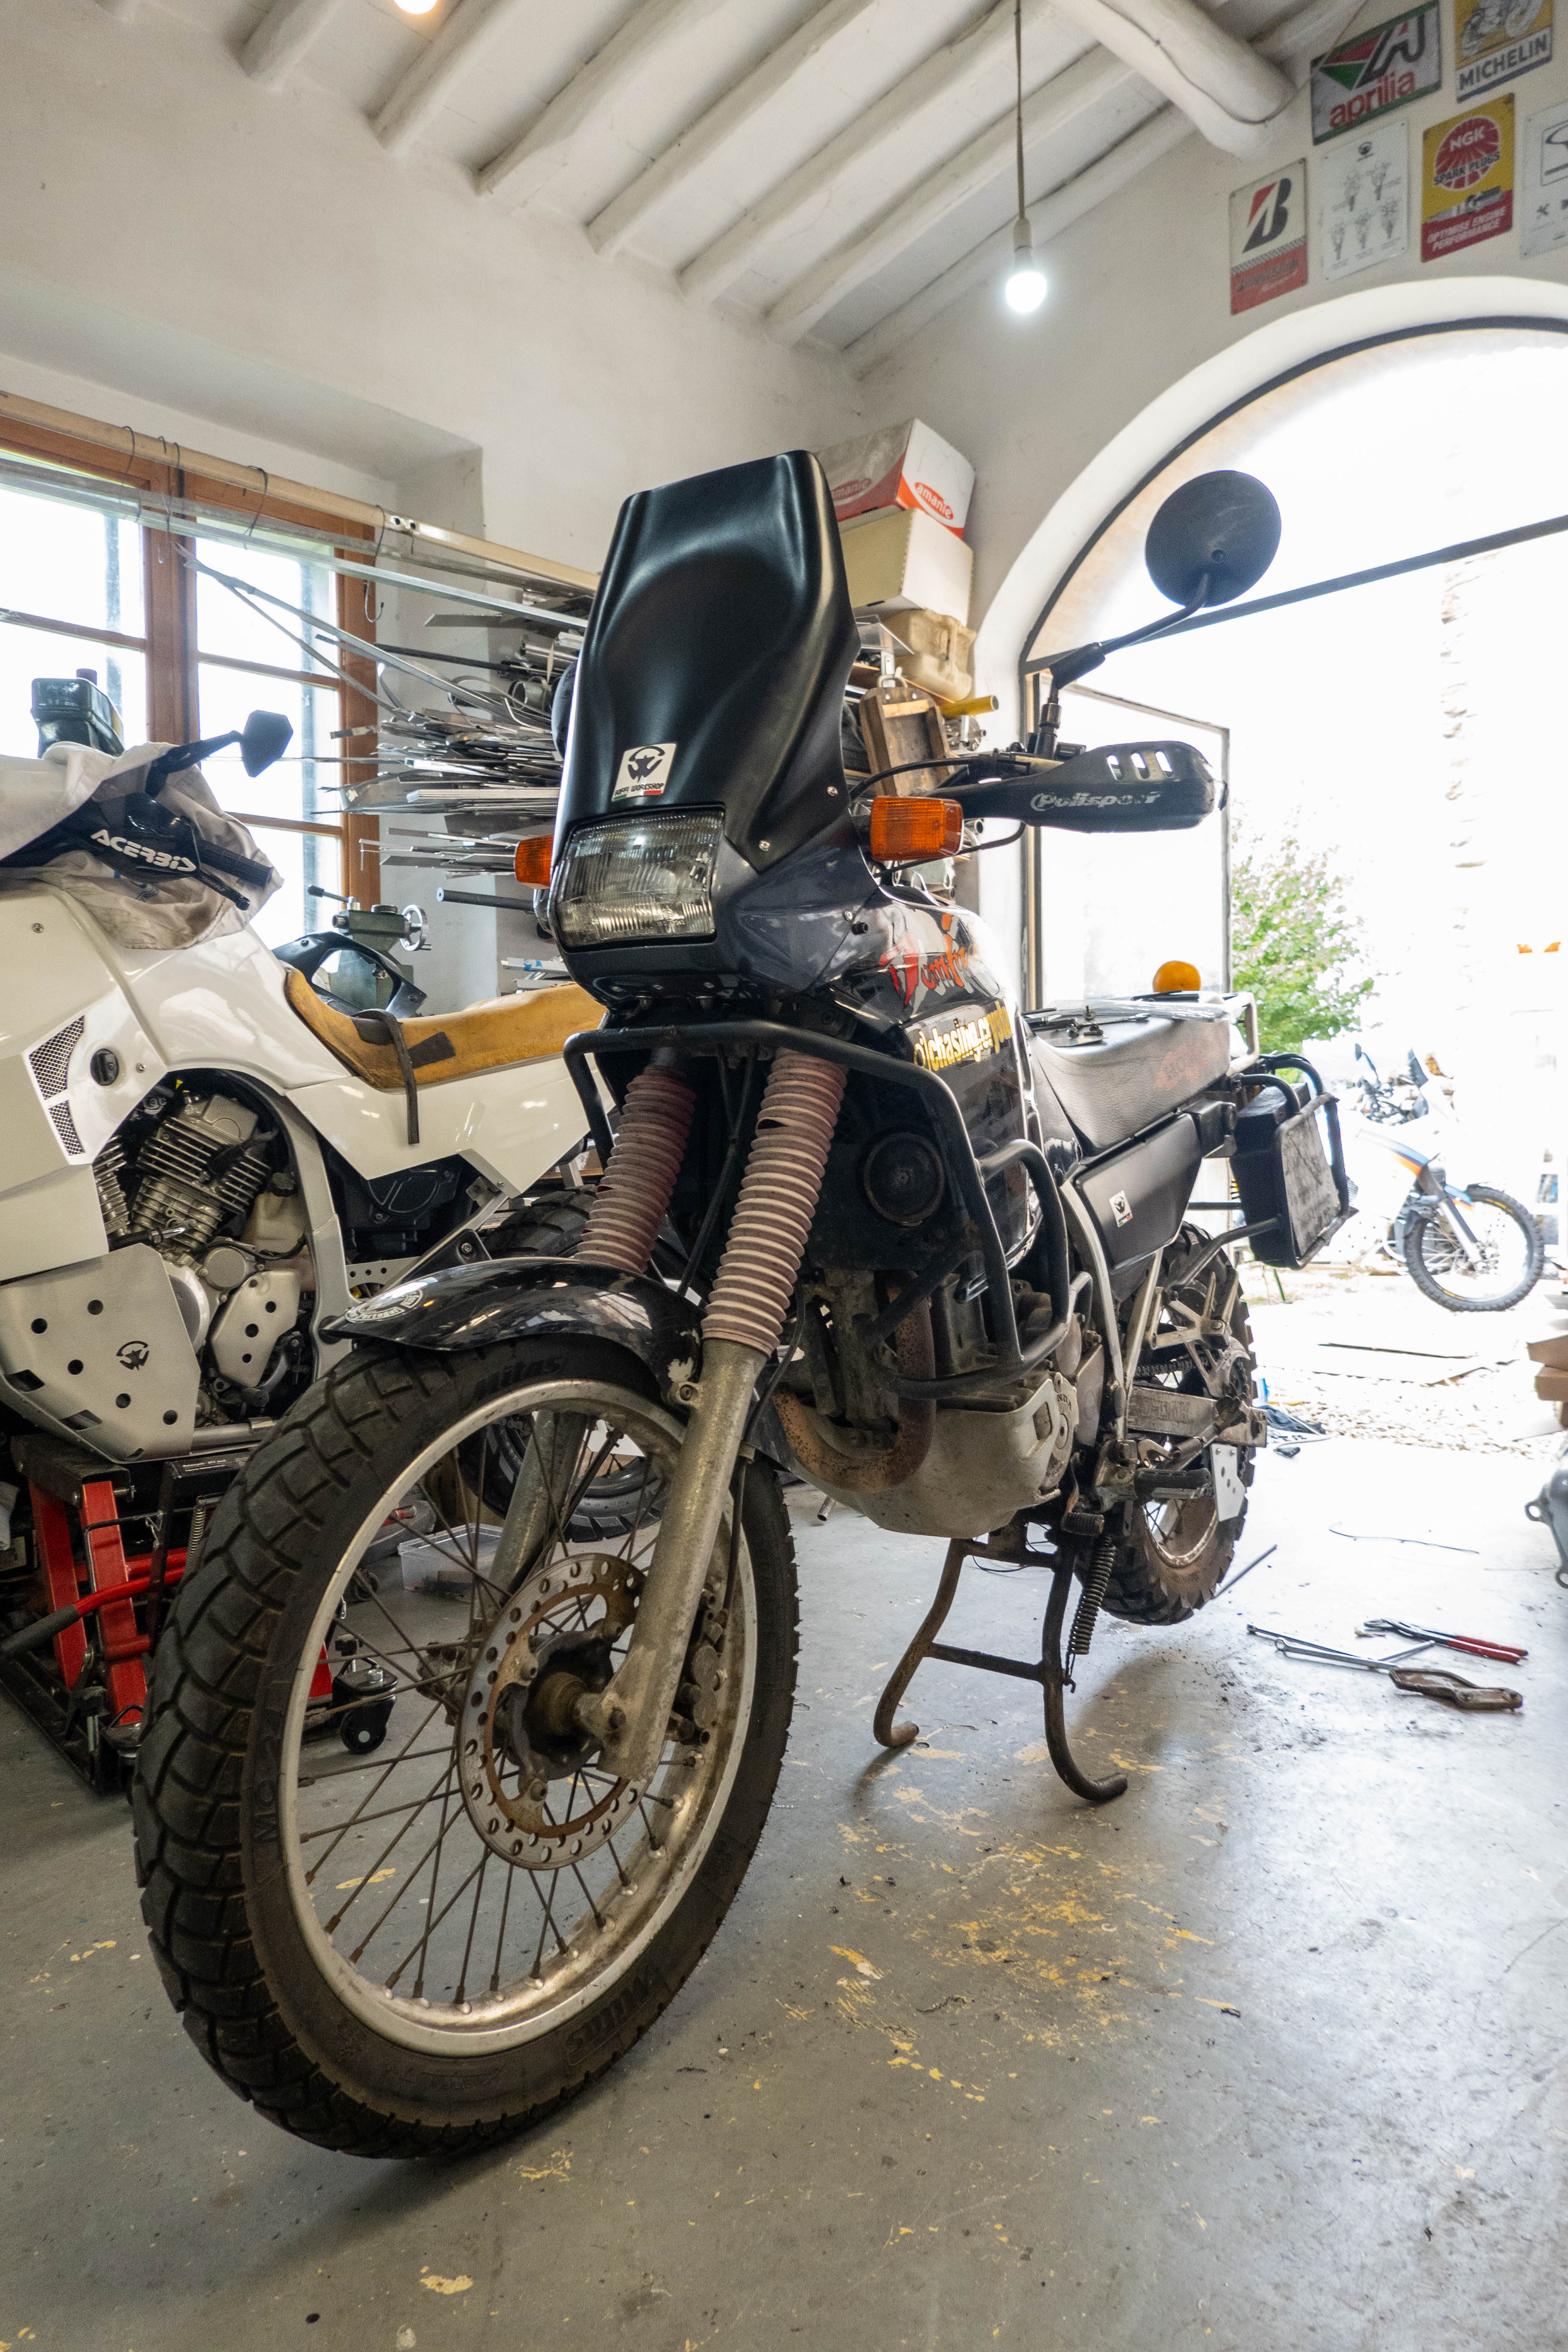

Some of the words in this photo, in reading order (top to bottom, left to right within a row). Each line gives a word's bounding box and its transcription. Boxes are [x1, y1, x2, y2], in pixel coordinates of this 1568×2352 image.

[1459, 34, 1547, 90] MICHELIN
[1329, 71, 1416, 128] aprilia
[1449, 125, 1485, 152] NGK
[1434, 164, 1466, 185] SPARK
[1469, 151, 1501, 170] PLUGS
[1471, 206, 1507, 227] ENGINE
[1432, 219, 1501, 252] PERFORMANCE
[1030, 791, 1161, 812] Polispot
[90, 829, 197, 872] ACERBIS
